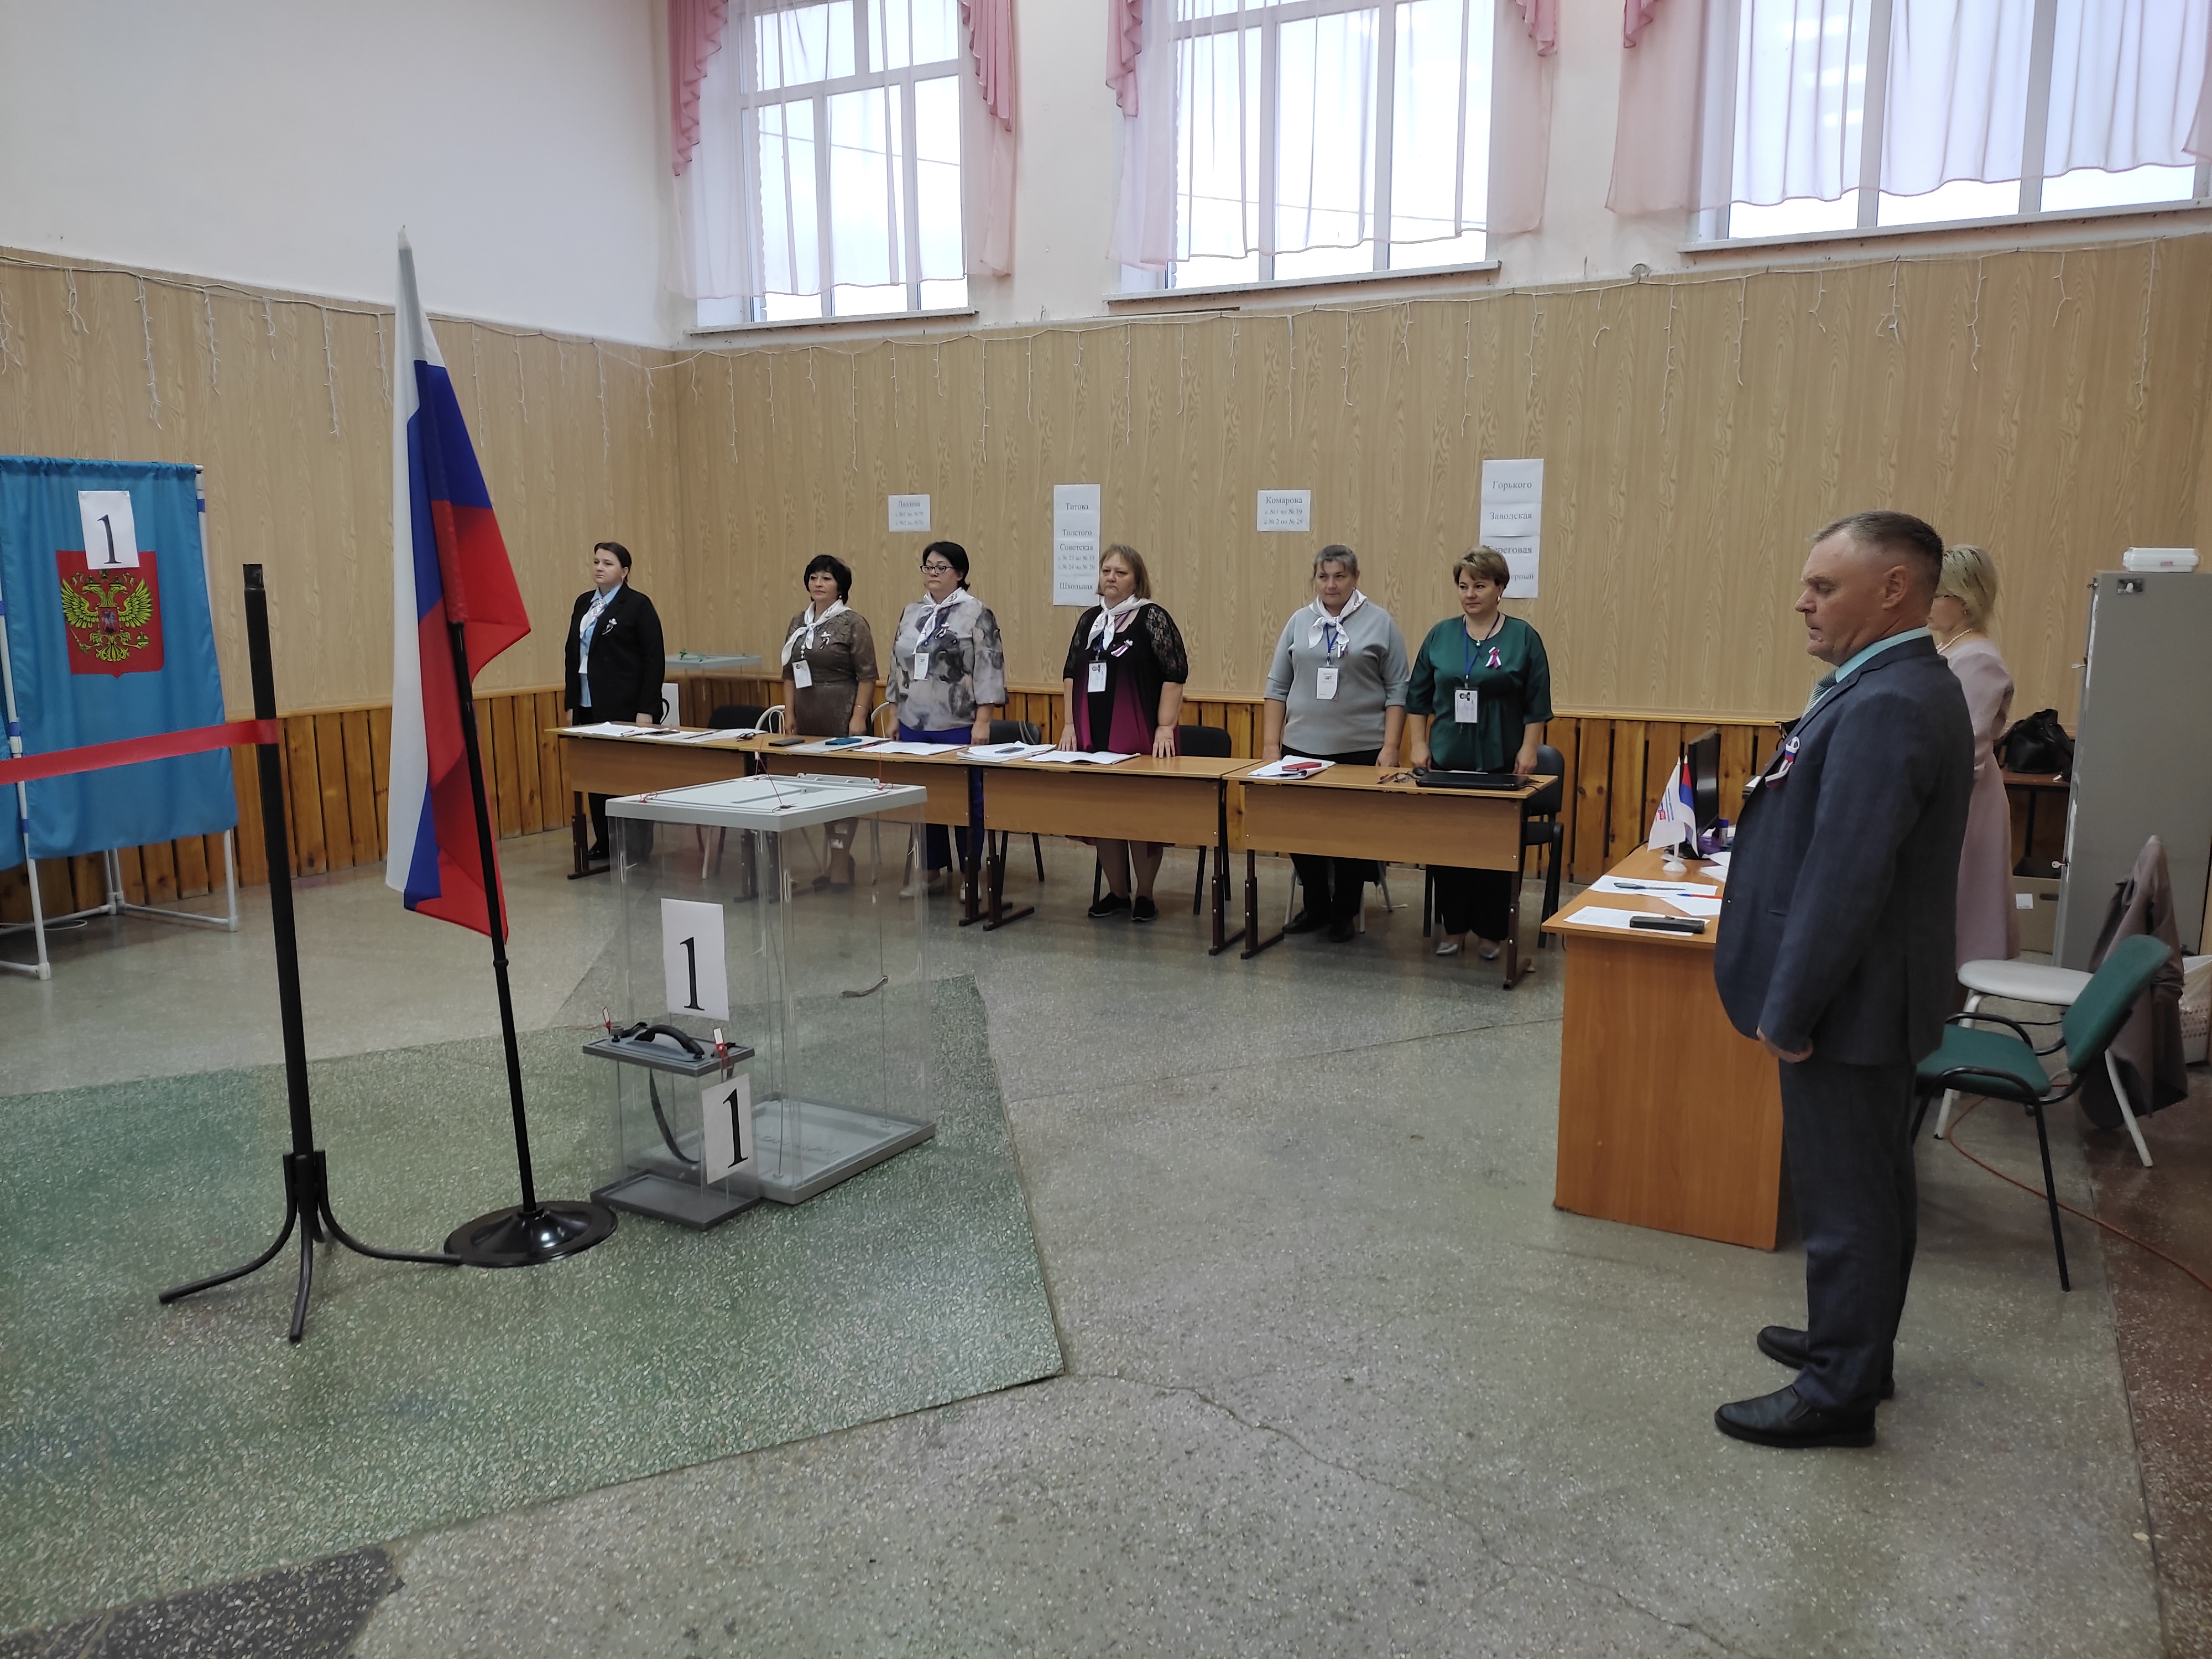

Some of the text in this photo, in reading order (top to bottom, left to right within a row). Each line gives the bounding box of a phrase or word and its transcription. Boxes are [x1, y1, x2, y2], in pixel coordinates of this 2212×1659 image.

[1266, 497, 1302, 505] Комарова
[1493, 481, 1532, 491] Горького
[97, 514, 122, 564] 1
[1510, 573, 1533, 581] ерный
[679, 936, 705, 1011] 1
[722, 1088, 748, 1169] 1
